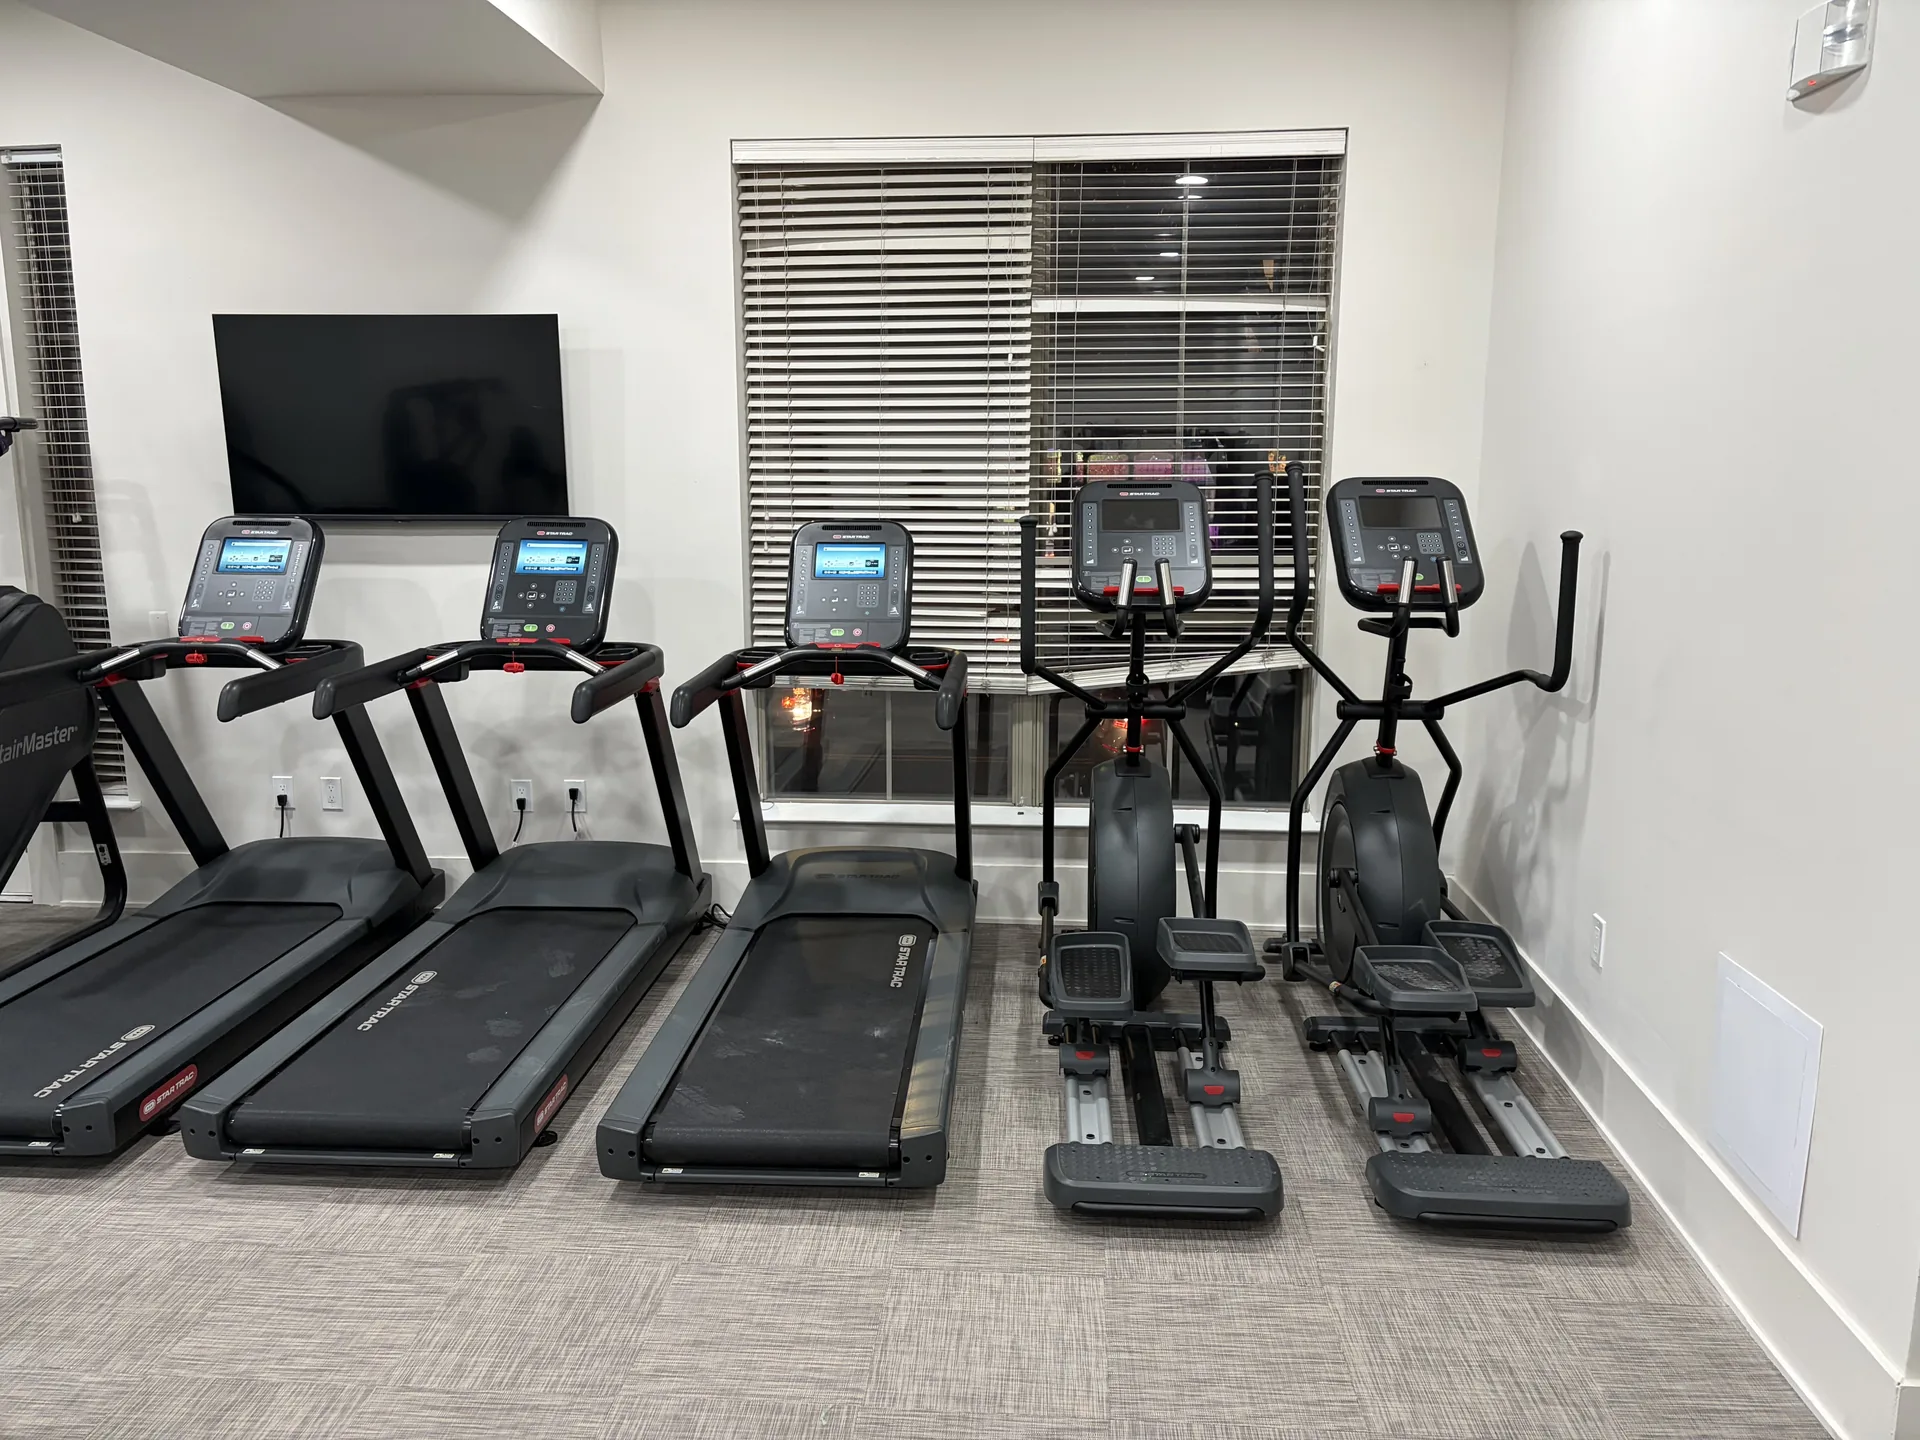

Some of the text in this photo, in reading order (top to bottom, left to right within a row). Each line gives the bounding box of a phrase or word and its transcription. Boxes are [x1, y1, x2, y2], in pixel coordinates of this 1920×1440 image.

[0, 725, 78, 764] tairMaster
[890, 946, 911, 988] STAR TRAC
[356, 984, 419, 1031] STAR TRAC
[33, 1041, 127, 1098] STAR TRAC
[156, 1071, 195, 1105] STAR TRAC
